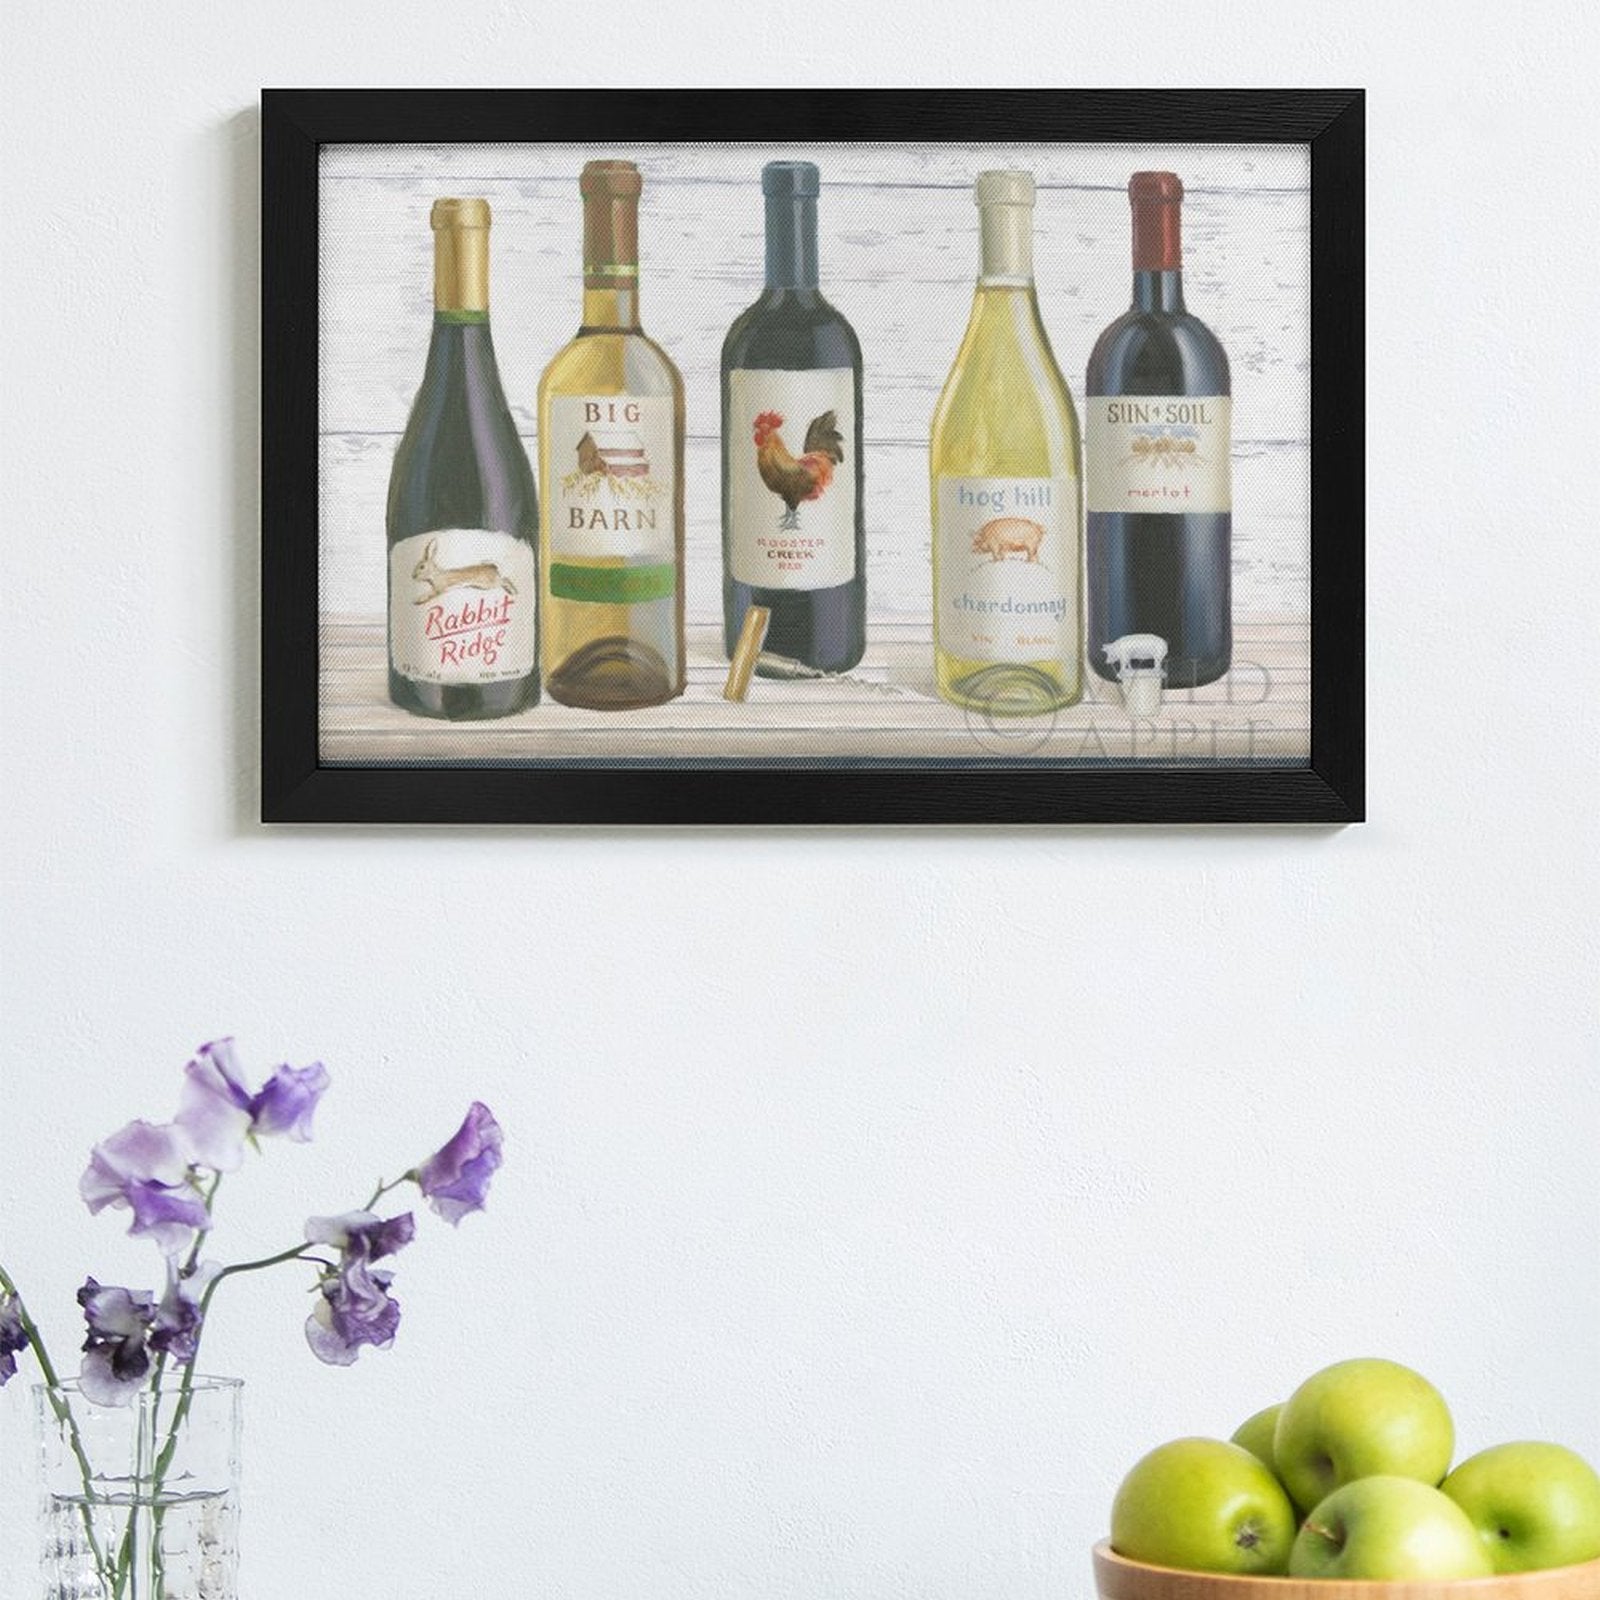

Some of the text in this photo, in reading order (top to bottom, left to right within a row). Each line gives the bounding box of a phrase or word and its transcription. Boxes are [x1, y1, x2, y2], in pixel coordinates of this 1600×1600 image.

[584, 402, 641, 423] BIG
[1166, 403, 1212, 424] SOIL
[958, 486, 1051, 513] hog hill
[1127, 485, 1191, 498] merlot
[568, 507, 656, 531] BARN
[766, 550, 815, 560] CREEK
[425, 595, 514, 637] Rabbit
[952, 594, 1067, 623] chardonnay
[440, 629, 506, 667] Ridge
